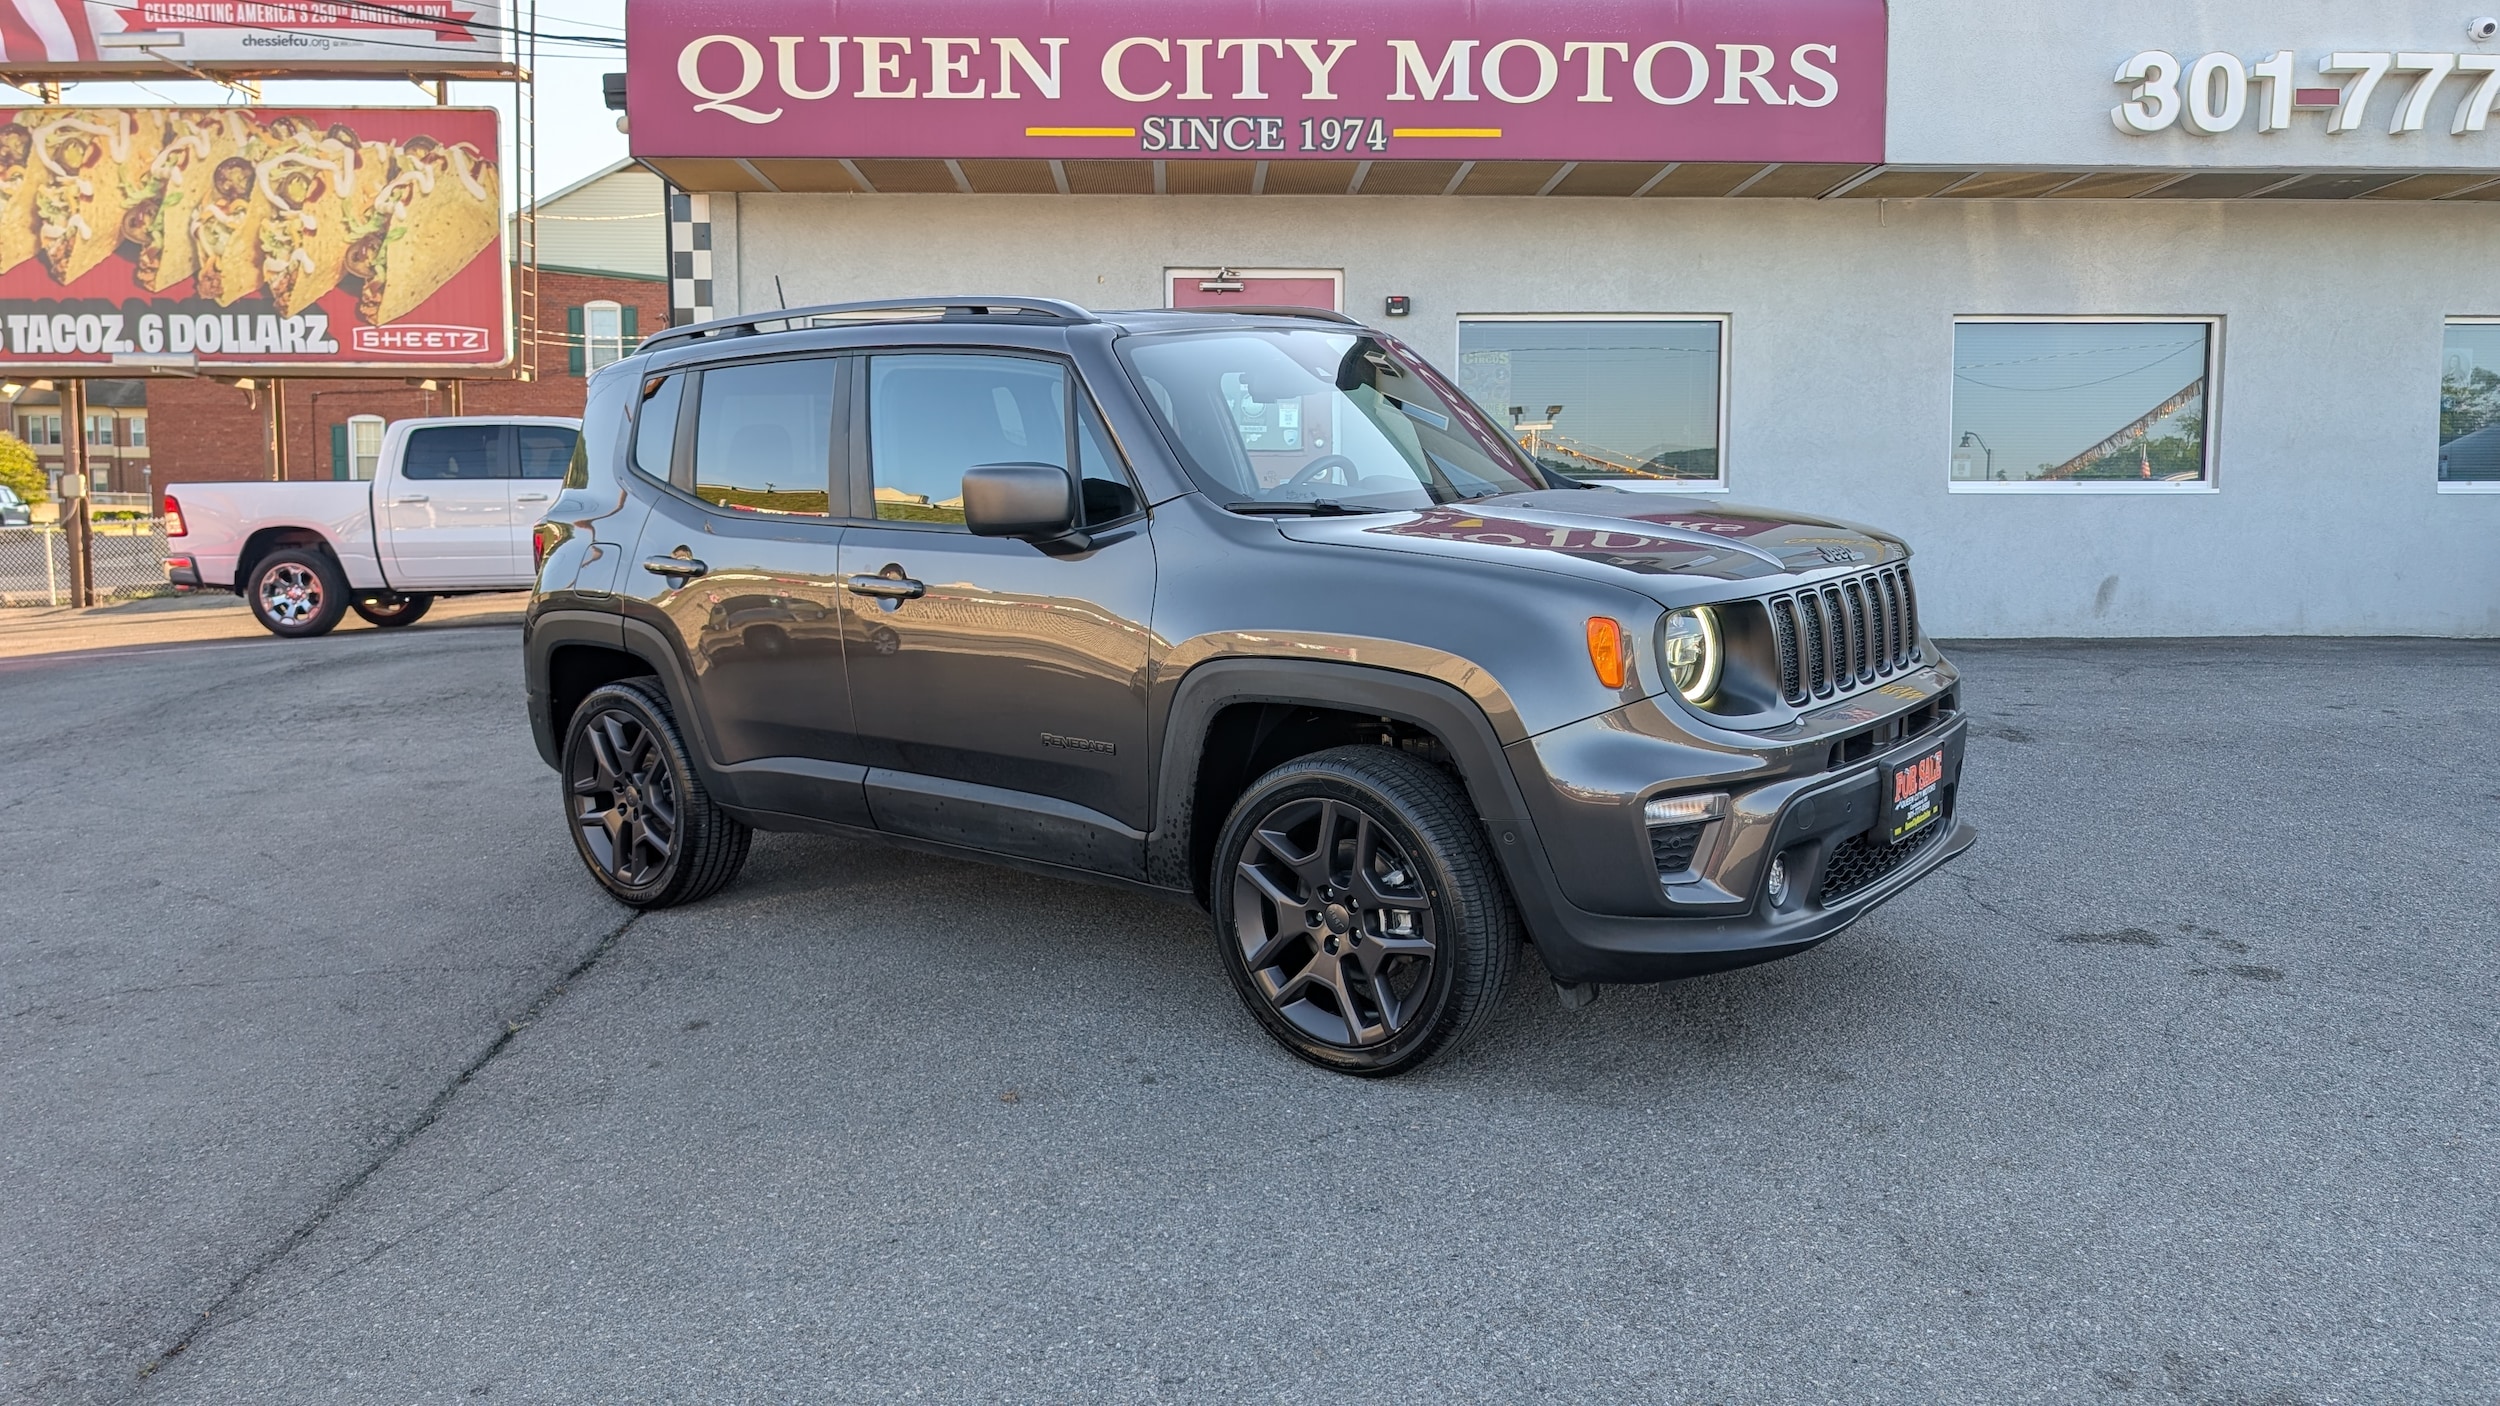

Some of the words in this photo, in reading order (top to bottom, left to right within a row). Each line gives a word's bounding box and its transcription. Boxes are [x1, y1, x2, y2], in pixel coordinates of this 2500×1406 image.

[144, 3, 234, 23] CELEBRATING
[236, 3, 309, 23] AMERICA'S
[350, 4, 447, 25] ANNIVERSARY!
[242, 34, 330, 50] chessiefcu.org
[677, 34, 1070, 125] QUEEN
[1100, 36, 1357, 102] CITY
[1386, 38, 1840, 108] MOTORS
[1141, 116, 1286, 152] SINCE
[1299, 117, 1388, 153] 1974
[7, 314, 135, 354] TACOZ.
[138, 314, 165, 354] 6
[168, 314, 339, 355] DOLLARZ.
[363, 331, 479, 348] SHEETZ
[1040, 732, 1116, 756] RENEGADE
[1894, 765, 1917, 803] FOR
[1919, 750, 1942, 790] SALE
